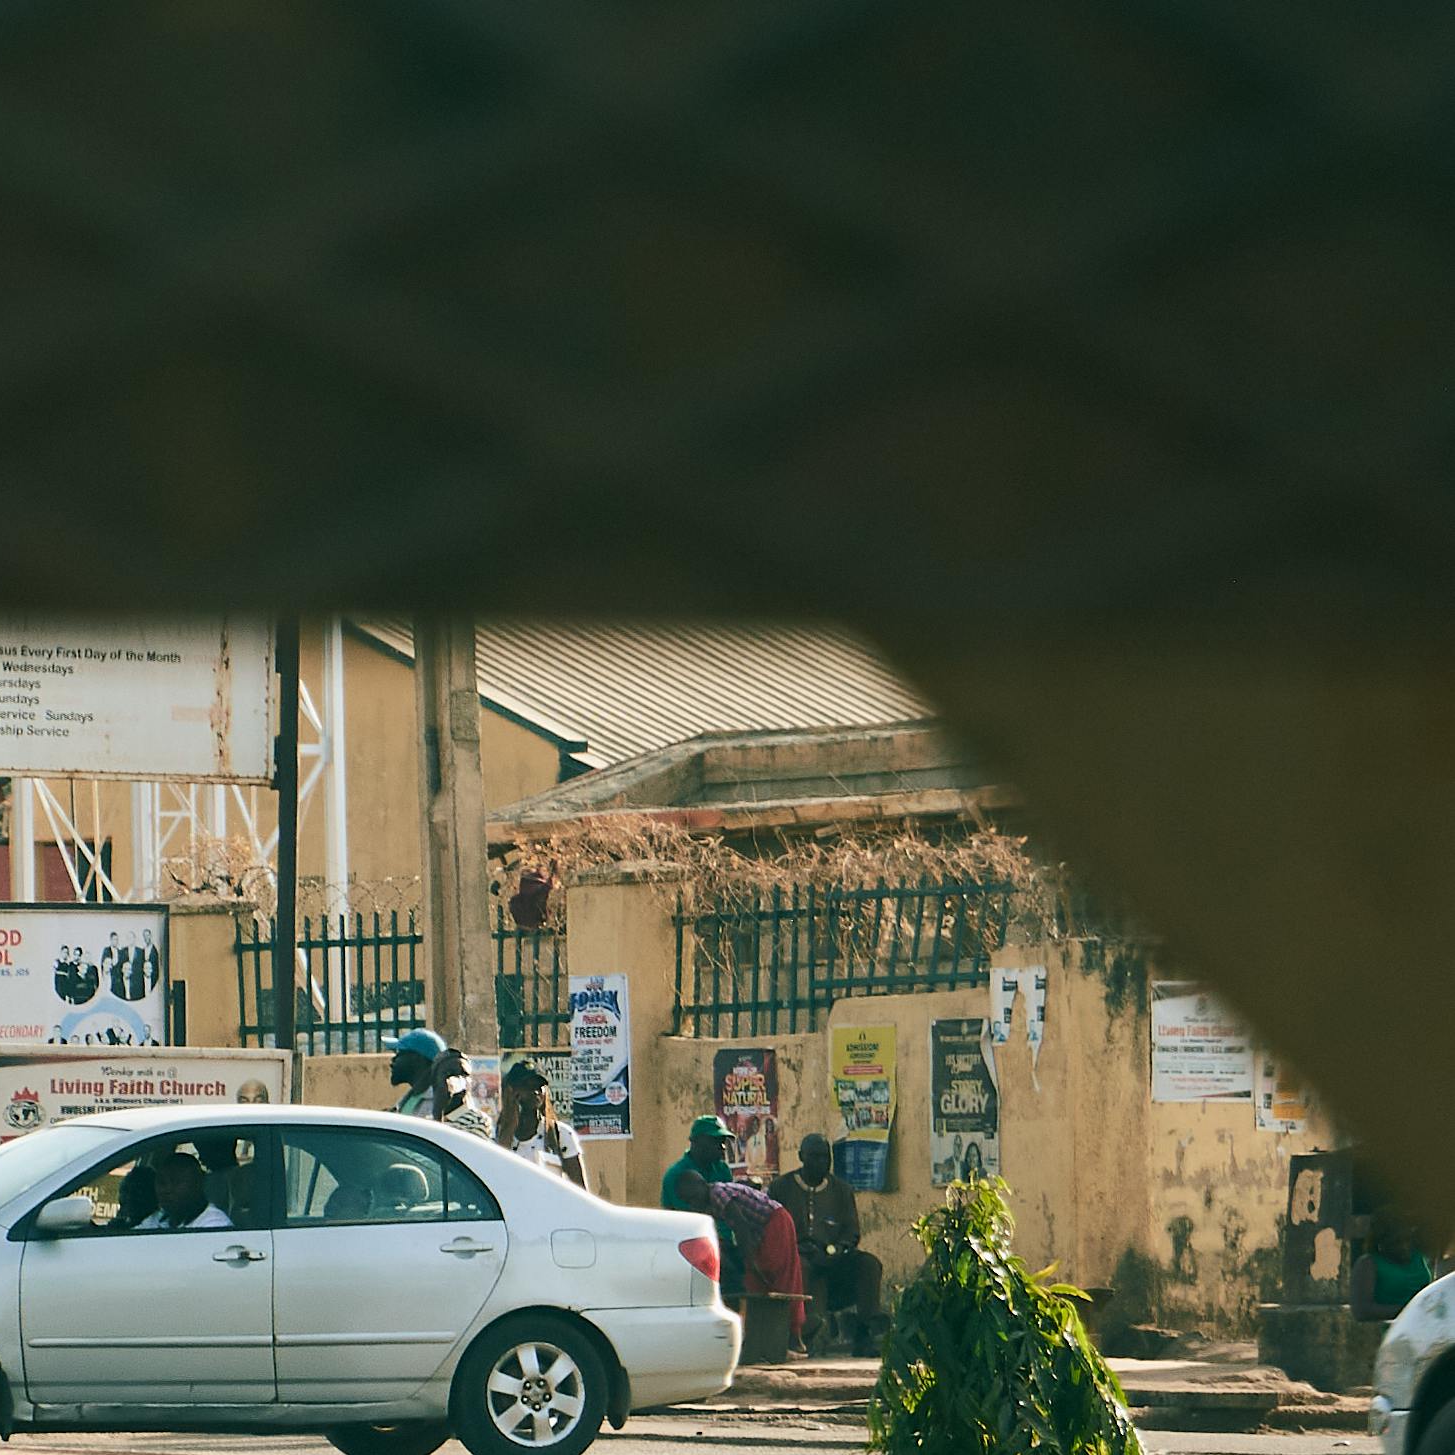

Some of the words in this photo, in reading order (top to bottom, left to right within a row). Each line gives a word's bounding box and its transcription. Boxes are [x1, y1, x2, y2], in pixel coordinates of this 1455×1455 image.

[20, 645, 53, 660] Every
[56, 646, 82, 659] First
[84, 648, 107, 662] Day
[110, 649, 122, 660] of
[125, 650, 143, 661] the
[146, 651, 181, 663] Month
[2, 661, 74, 675] Wednesdays
[45, 710, 94, 723] Sundays
[26, 725, 70, 738] Service
[574, 1026, 618, 1039] FREEDOM
[50, 1078, 104, 1096] Living
[109, 1079, 154, 1095] Faith
[159, 1079, 226, 1097] Church
[725, 1073, 765, 1092] SUPER
[722, 1089, 770, 1105] NATURAL
[940, 1092, 988, 1114] GLORY
